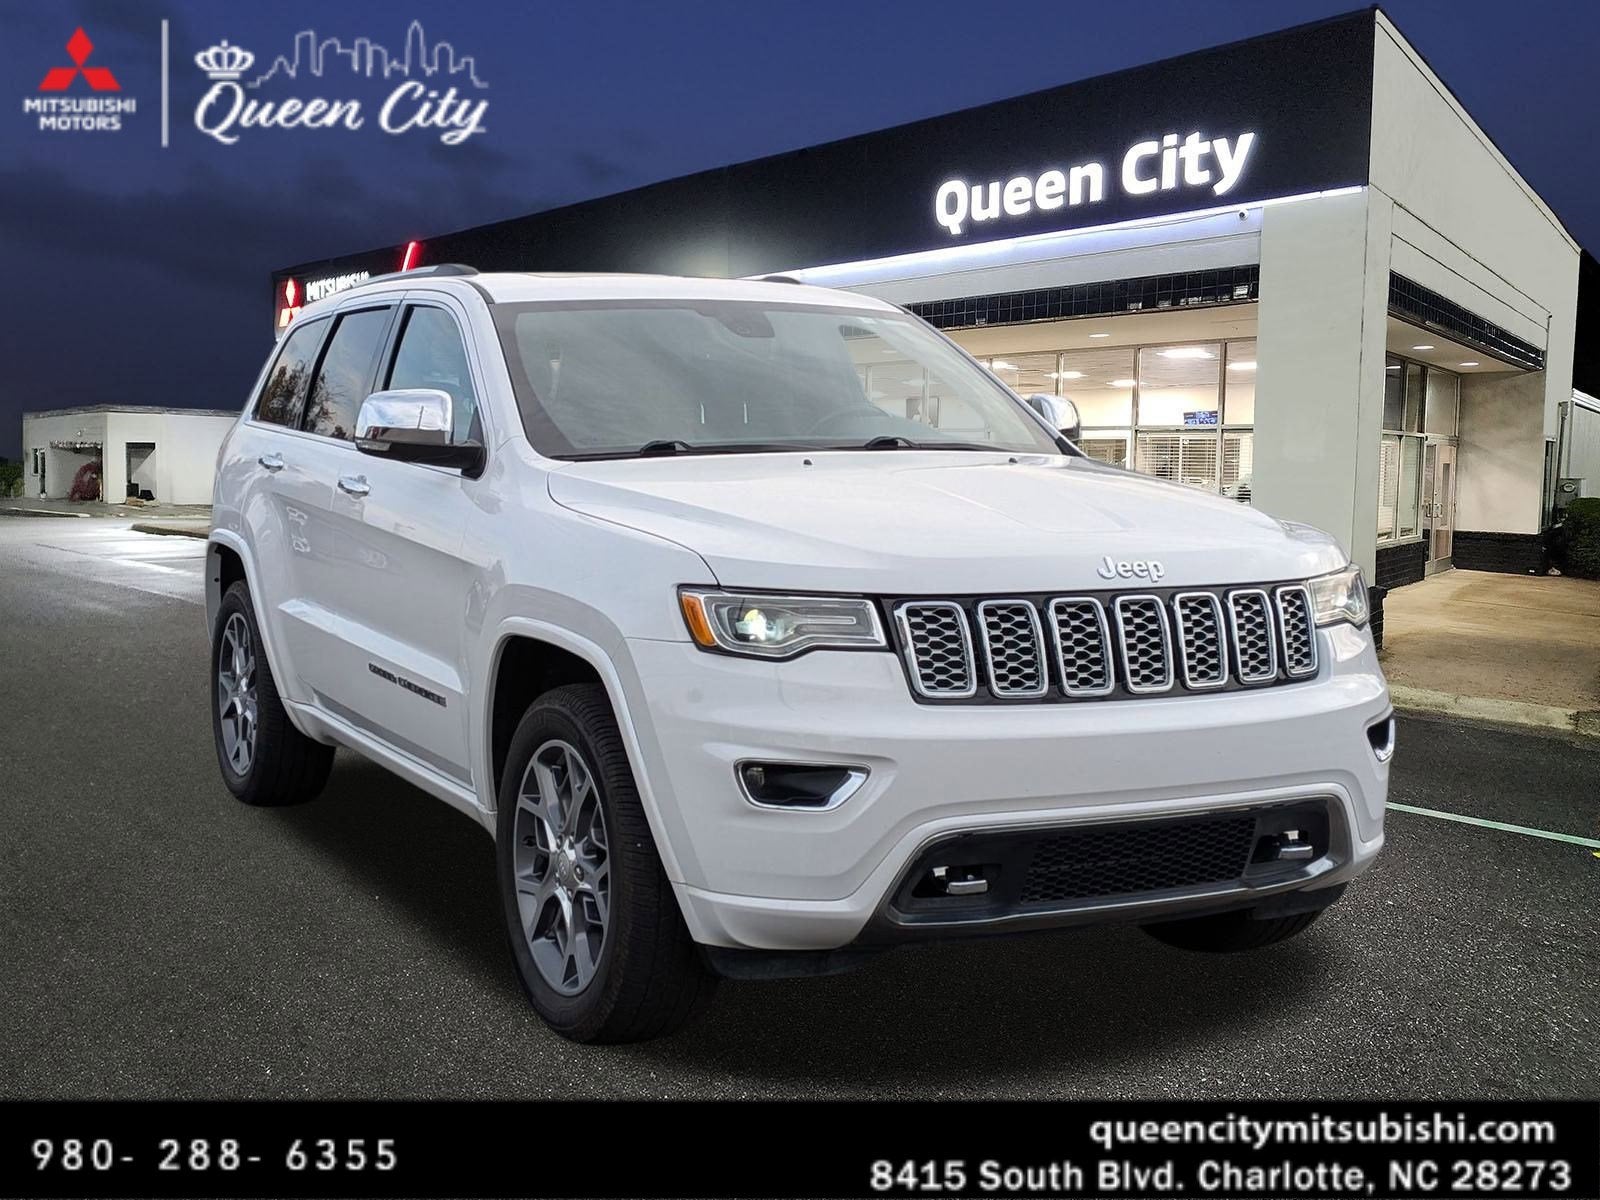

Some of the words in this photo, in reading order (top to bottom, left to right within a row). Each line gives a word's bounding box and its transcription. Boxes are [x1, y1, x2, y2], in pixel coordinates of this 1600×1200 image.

[935, 162, 1103, 235] Queen
[1121, 131, 1256, 196] City
[1097, 556, 1164, 583] Jeep
